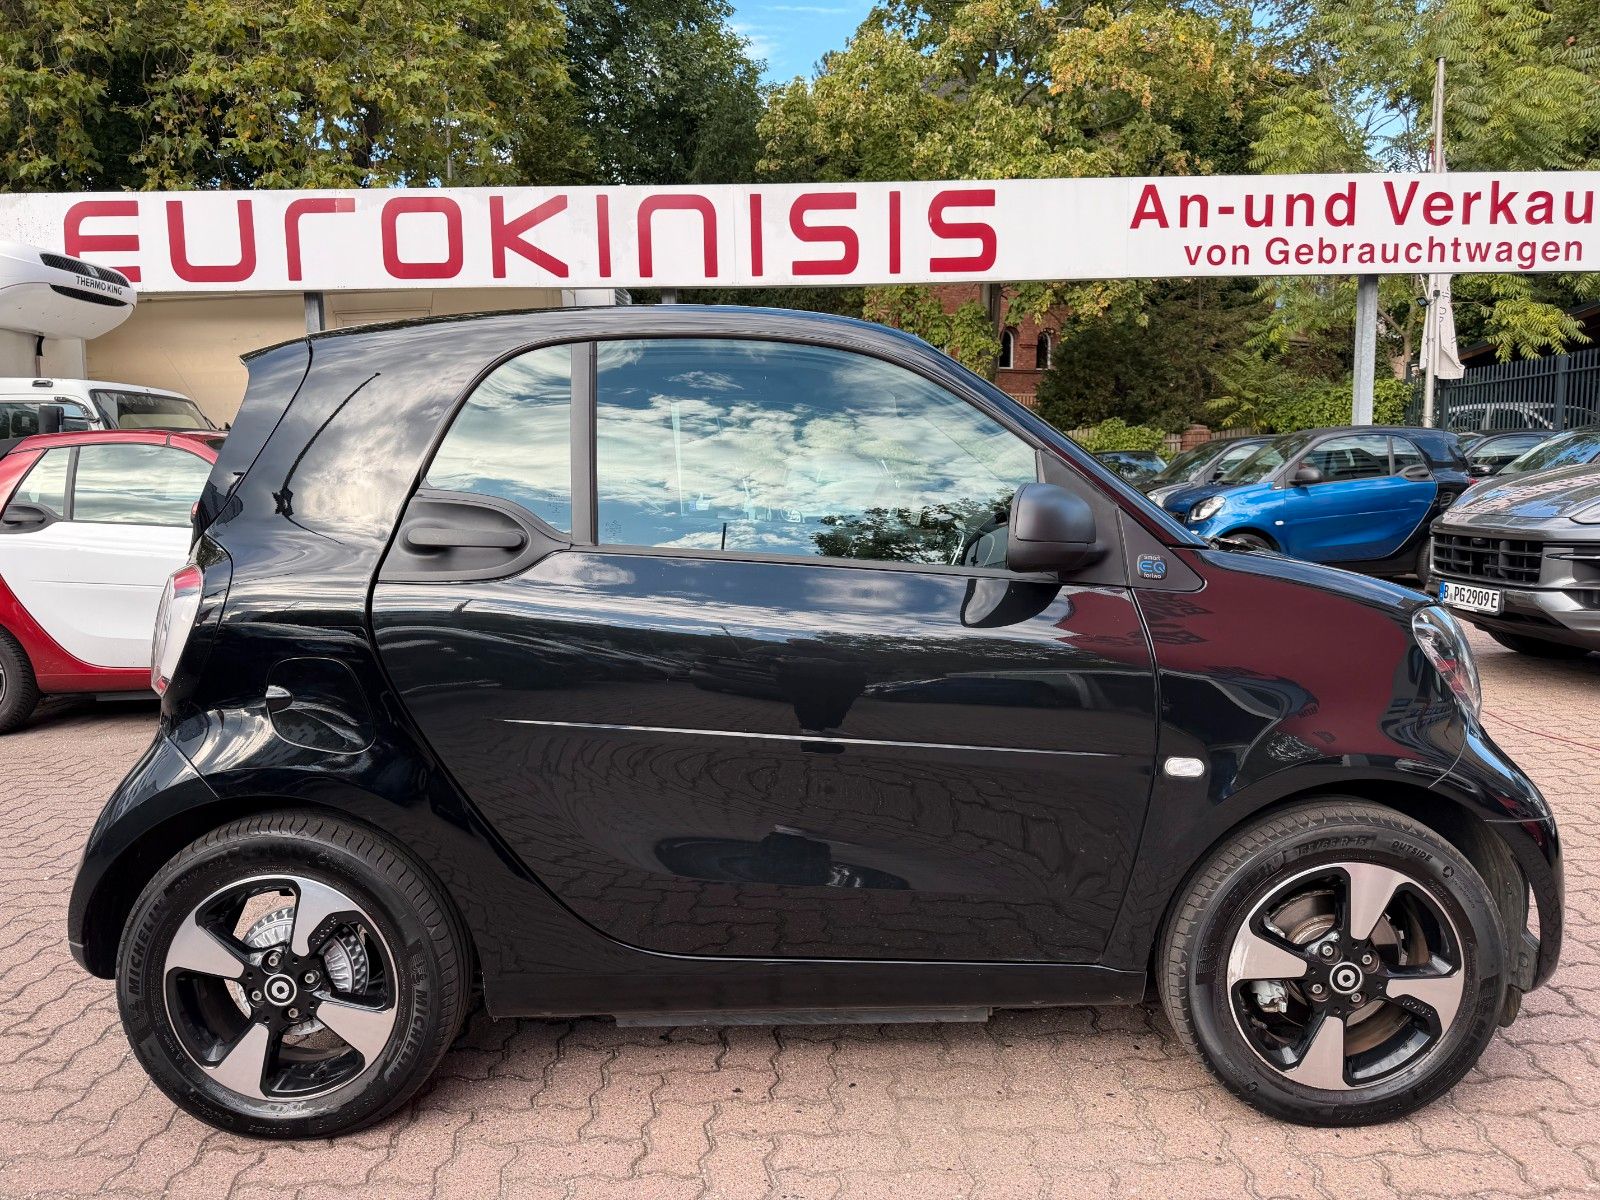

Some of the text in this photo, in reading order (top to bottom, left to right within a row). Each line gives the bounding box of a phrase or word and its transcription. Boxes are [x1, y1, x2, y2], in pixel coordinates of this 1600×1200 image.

[1383, 180, 1594, 227] Verkau
[1184, 237, 1583, 271] von Gebrauchtwagen
[75, 275, 123, 296] THERMO KING
[1139, 560, 1166, 574] EQ
[1443, 584, 1450, 599] B
[1392, 840, 1433, 862] OUTSIDE
